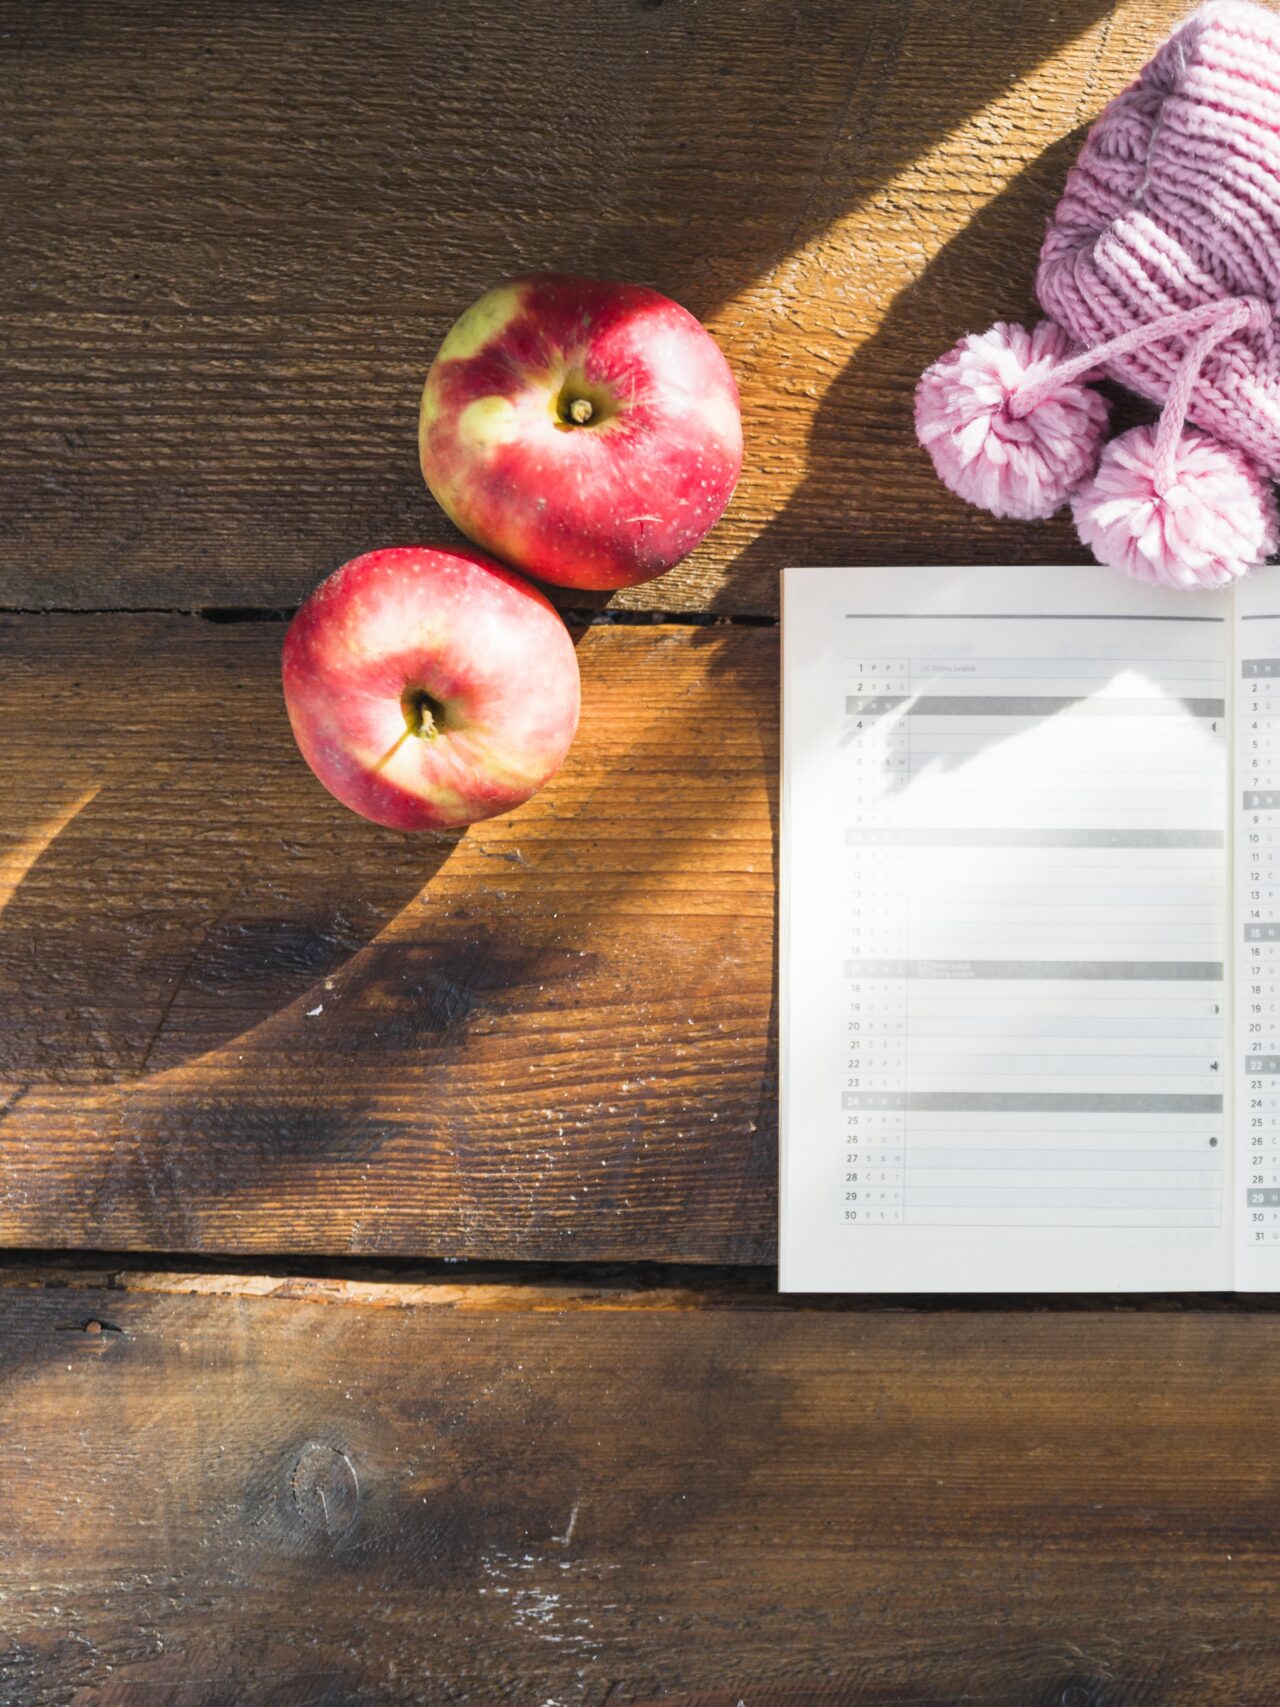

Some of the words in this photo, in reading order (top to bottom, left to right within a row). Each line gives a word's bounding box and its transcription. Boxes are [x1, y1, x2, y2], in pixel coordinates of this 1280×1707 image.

[858, 663, 863, 673] 1
[1252, 664, 1258, 674] 1
[857, 682, 863, 692] 2
[1252, 683, 1258, 693] 2
[856, 701, 864, 711] 3
[1252, 702, 1258, 712] 3
[856, 720, 863, 729] 4
[1251, 721, 1258, 729] 4
[1252, 740, 1258, 749] 5
[1252, 759, 1258, 768] 6
[1253, 777, 1259, 787] 7
[1252, 796, 1259, 806] 8
[1252, 815, 1259, 824] 9
[1248, 834, 1260, 844] 10
[1252, 853, 1260, 862] 11
[1250, 872, 1260, 881] 12
[1250, 890, 1260, 900] 13
[1250, 910, 1260, 918] 14
[1250, 928, 1261, 938] 15
[1251, 947, 1261, 957] 16
[1251, 966, 1261, 975] 17
[852, 984, 861, 993] 18
[1251, 985, 1261, 994] 18
[851, 1003, 861, 1012] 19
[1251, 1004, 1262, 1013] 19
[848, 1021, 861, 1031] 20
[1249, 1023, 1262, 1033] 20
[850, 1040, 860, 1050] 21
[1252, 1042, 1262, 1052] 21
[848, 1059, 860, 1069] 22
[1250, 1060, 1262, 1071] 22
[847, 1078, 860, 1087] 23
[1251, 1080, 1263, 1089] 23
[846, 1096, 859, 1106] 24
[1250, 1099, 1263, 1108] 24
[847, 1116, 859, 1125] 25
[1251, 1118, 1263, 1127] 25
[846, 1135, 858, 1144] 26
[1251, 1137, 1263, 1146] 26
[846, 1154, 858, 1163] 27
[1252, 1156, 1264, 1165] 27
[846, 1172, 858, 1182] 28
[1252, 1175, 1264, 1184] 28
[845, 1191, 857, 1201] 29
[1251, 1193, 1265, 1204] 29
[844, 1210, 857, 1220] 30
[1252, 1213, 1265, 1222] 30
[1255, 1232, 1265, 1241] 31
